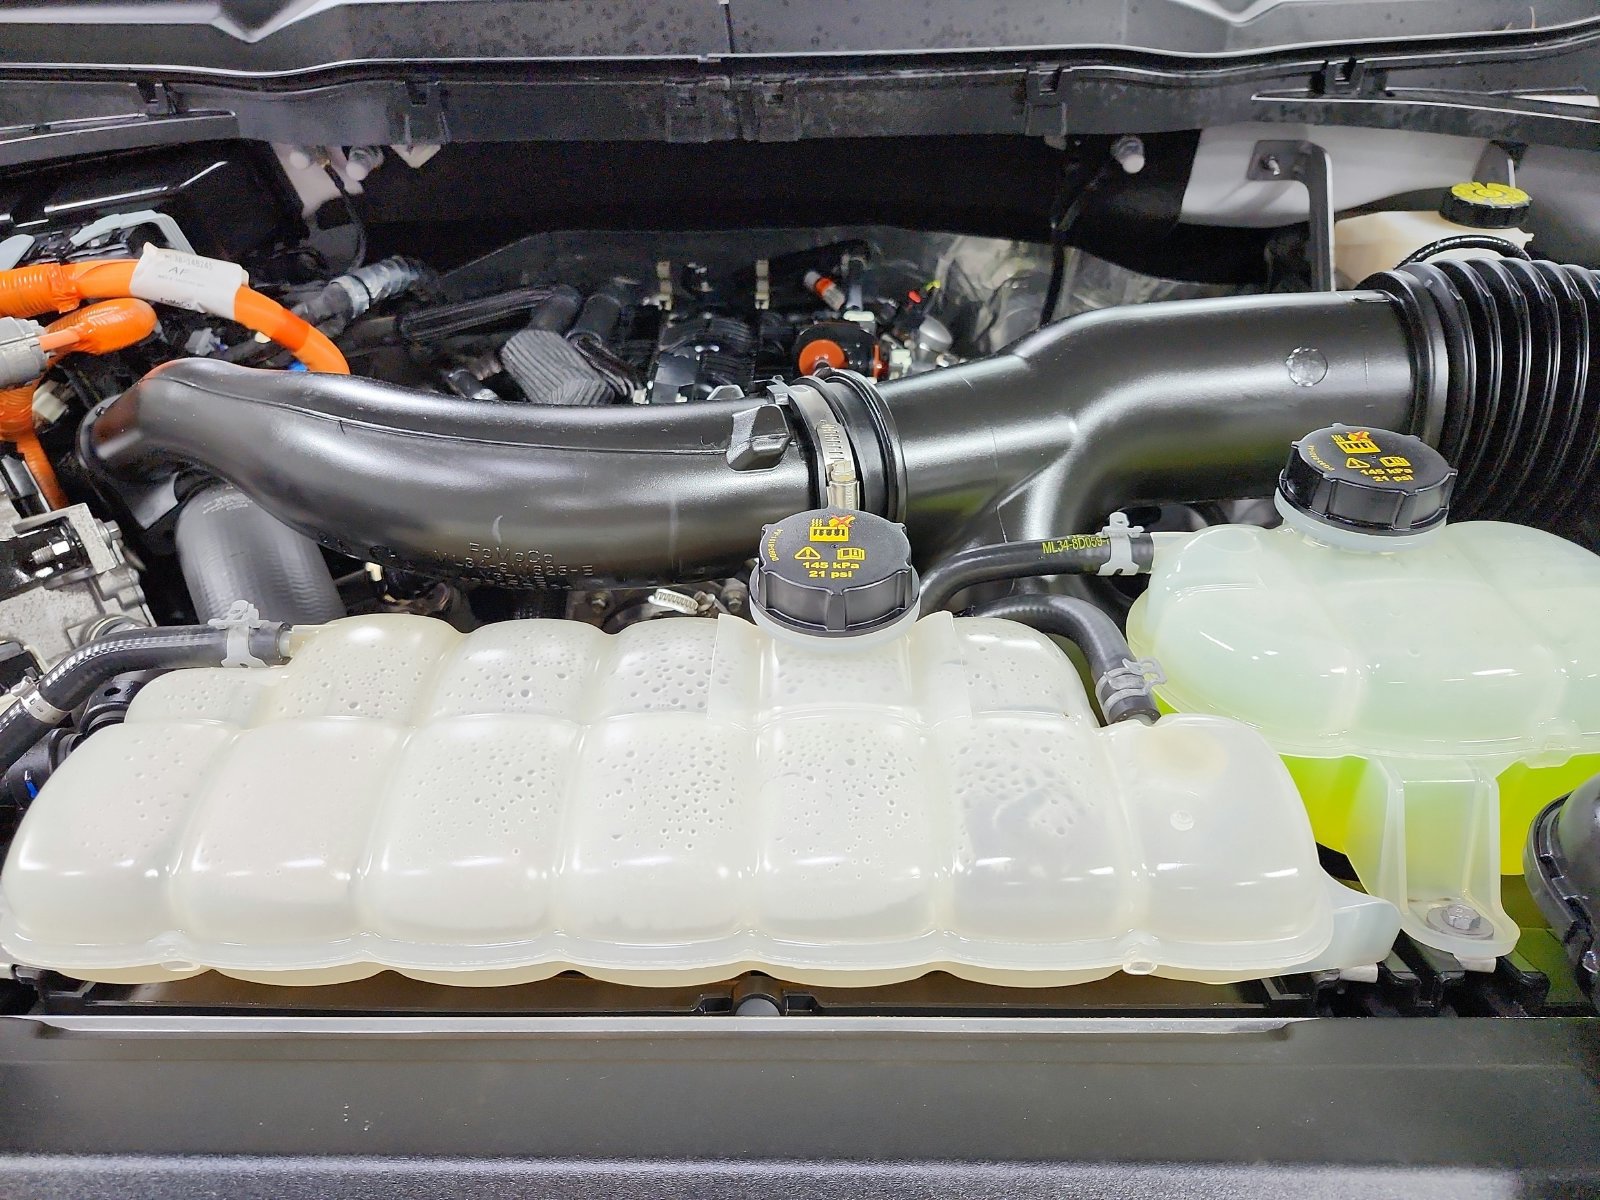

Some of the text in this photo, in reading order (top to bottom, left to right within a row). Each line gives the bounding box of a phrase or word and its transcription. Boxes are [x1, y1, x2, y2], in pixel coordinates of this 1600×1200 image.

[1360, 467, 1413, 476] 145 kPa
[1392, 474, 1414, 482] psi
[803, 561, 860, 569] 145 kPa
[808, 570, 852, 579] 21 psi
